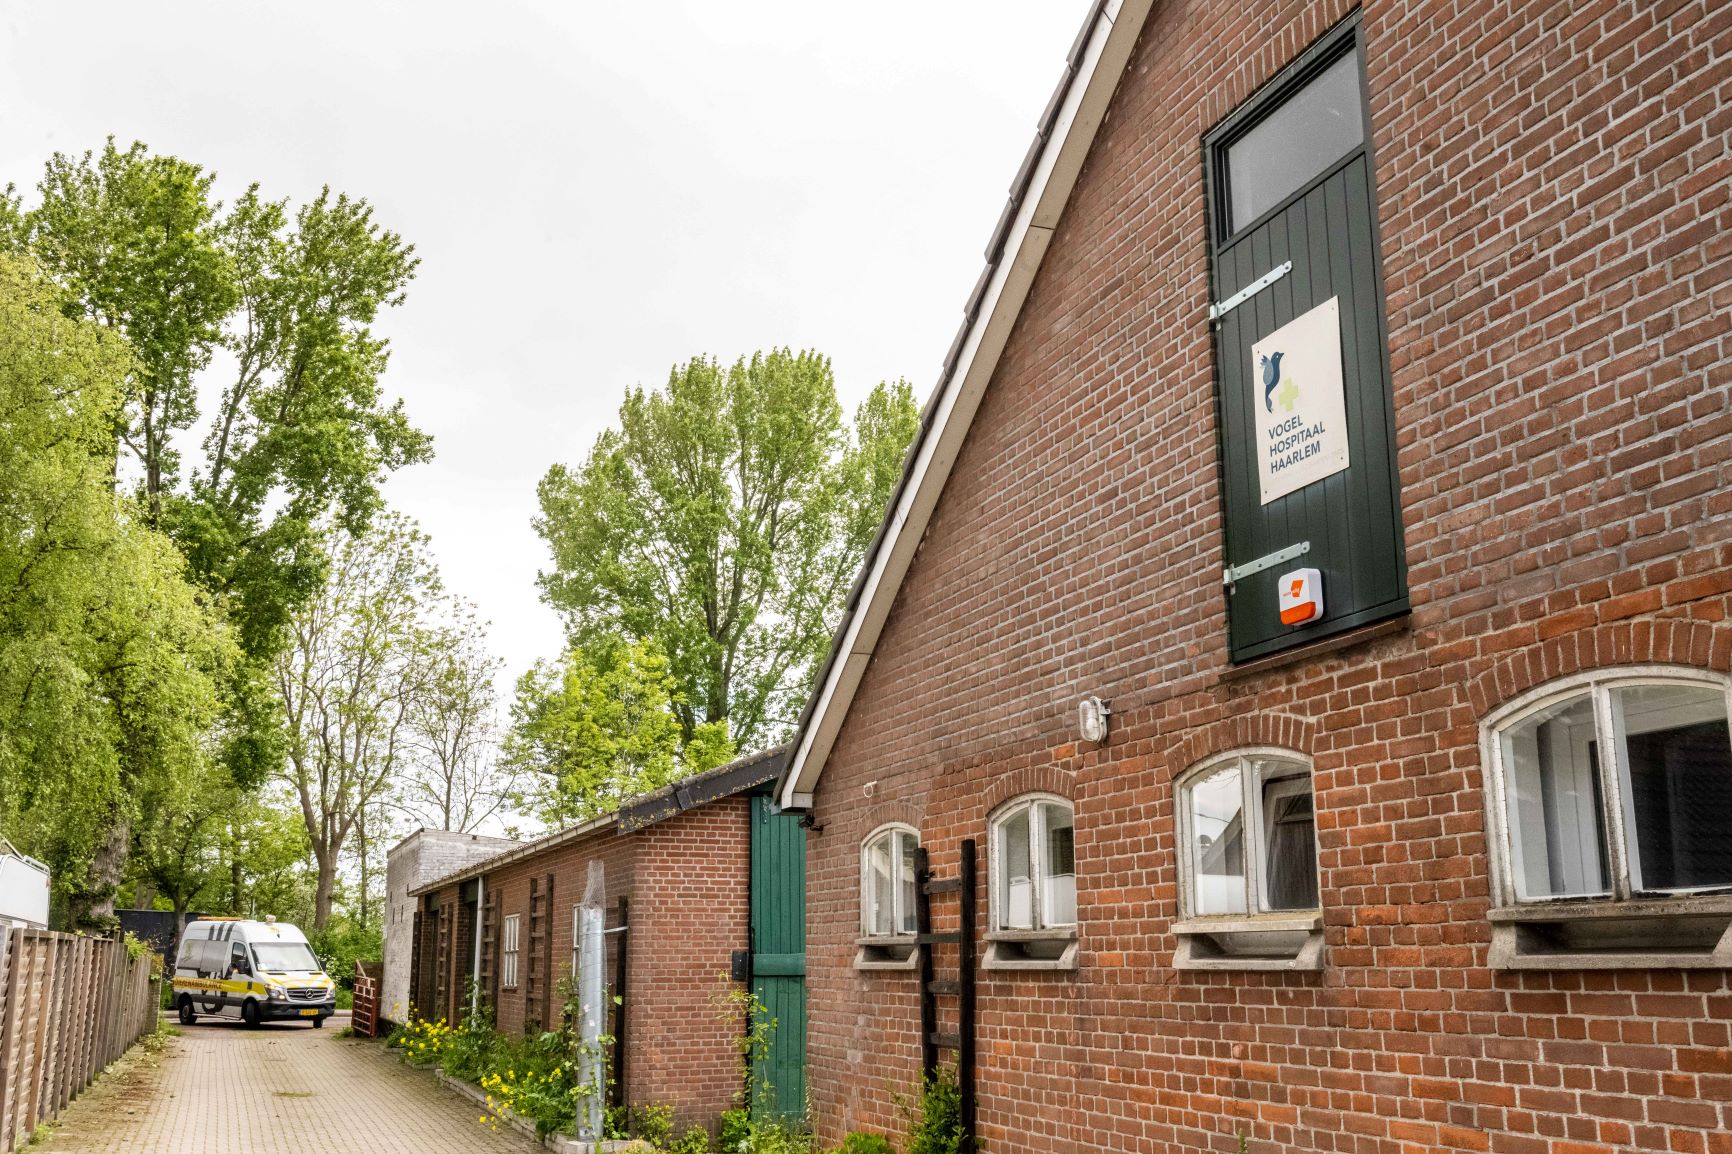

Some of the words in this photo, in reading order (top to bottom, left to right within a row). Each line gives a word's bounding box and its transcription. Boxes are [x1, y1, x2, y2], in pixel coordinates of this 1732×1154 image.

[1268, 414, 1303, 439] VOGEL
[1270, 421, 1326, 457] HOSPITAAL
[1271, 440, 1321, 474] HAARLEM
